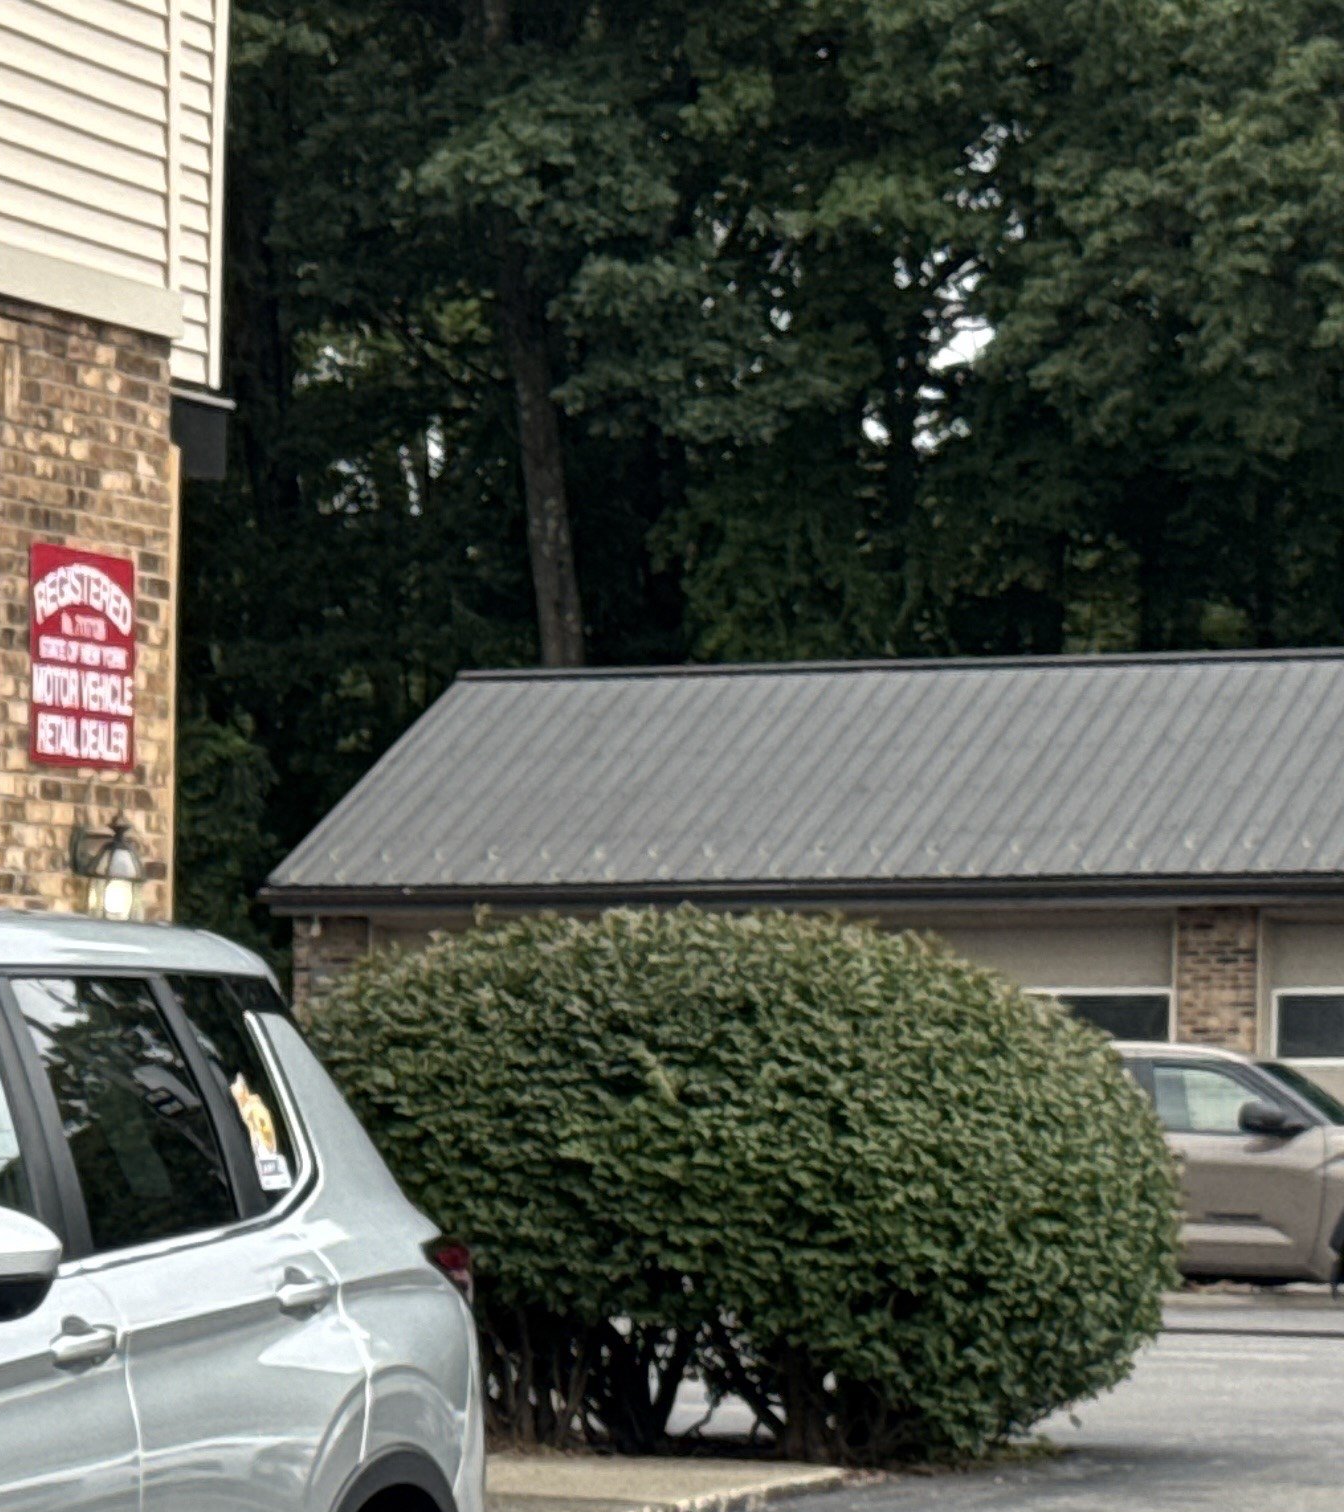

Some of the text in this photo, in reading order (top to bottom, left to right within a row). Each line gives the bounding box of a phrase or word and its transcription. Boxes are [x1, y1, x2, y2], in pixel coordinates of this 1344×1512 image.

[33, 562, 132, 637] REGISTERED
[33, 663, 133, 717] MOTOR VEHICLE
[36, 712, 129, 765] RETAIL DEALER
